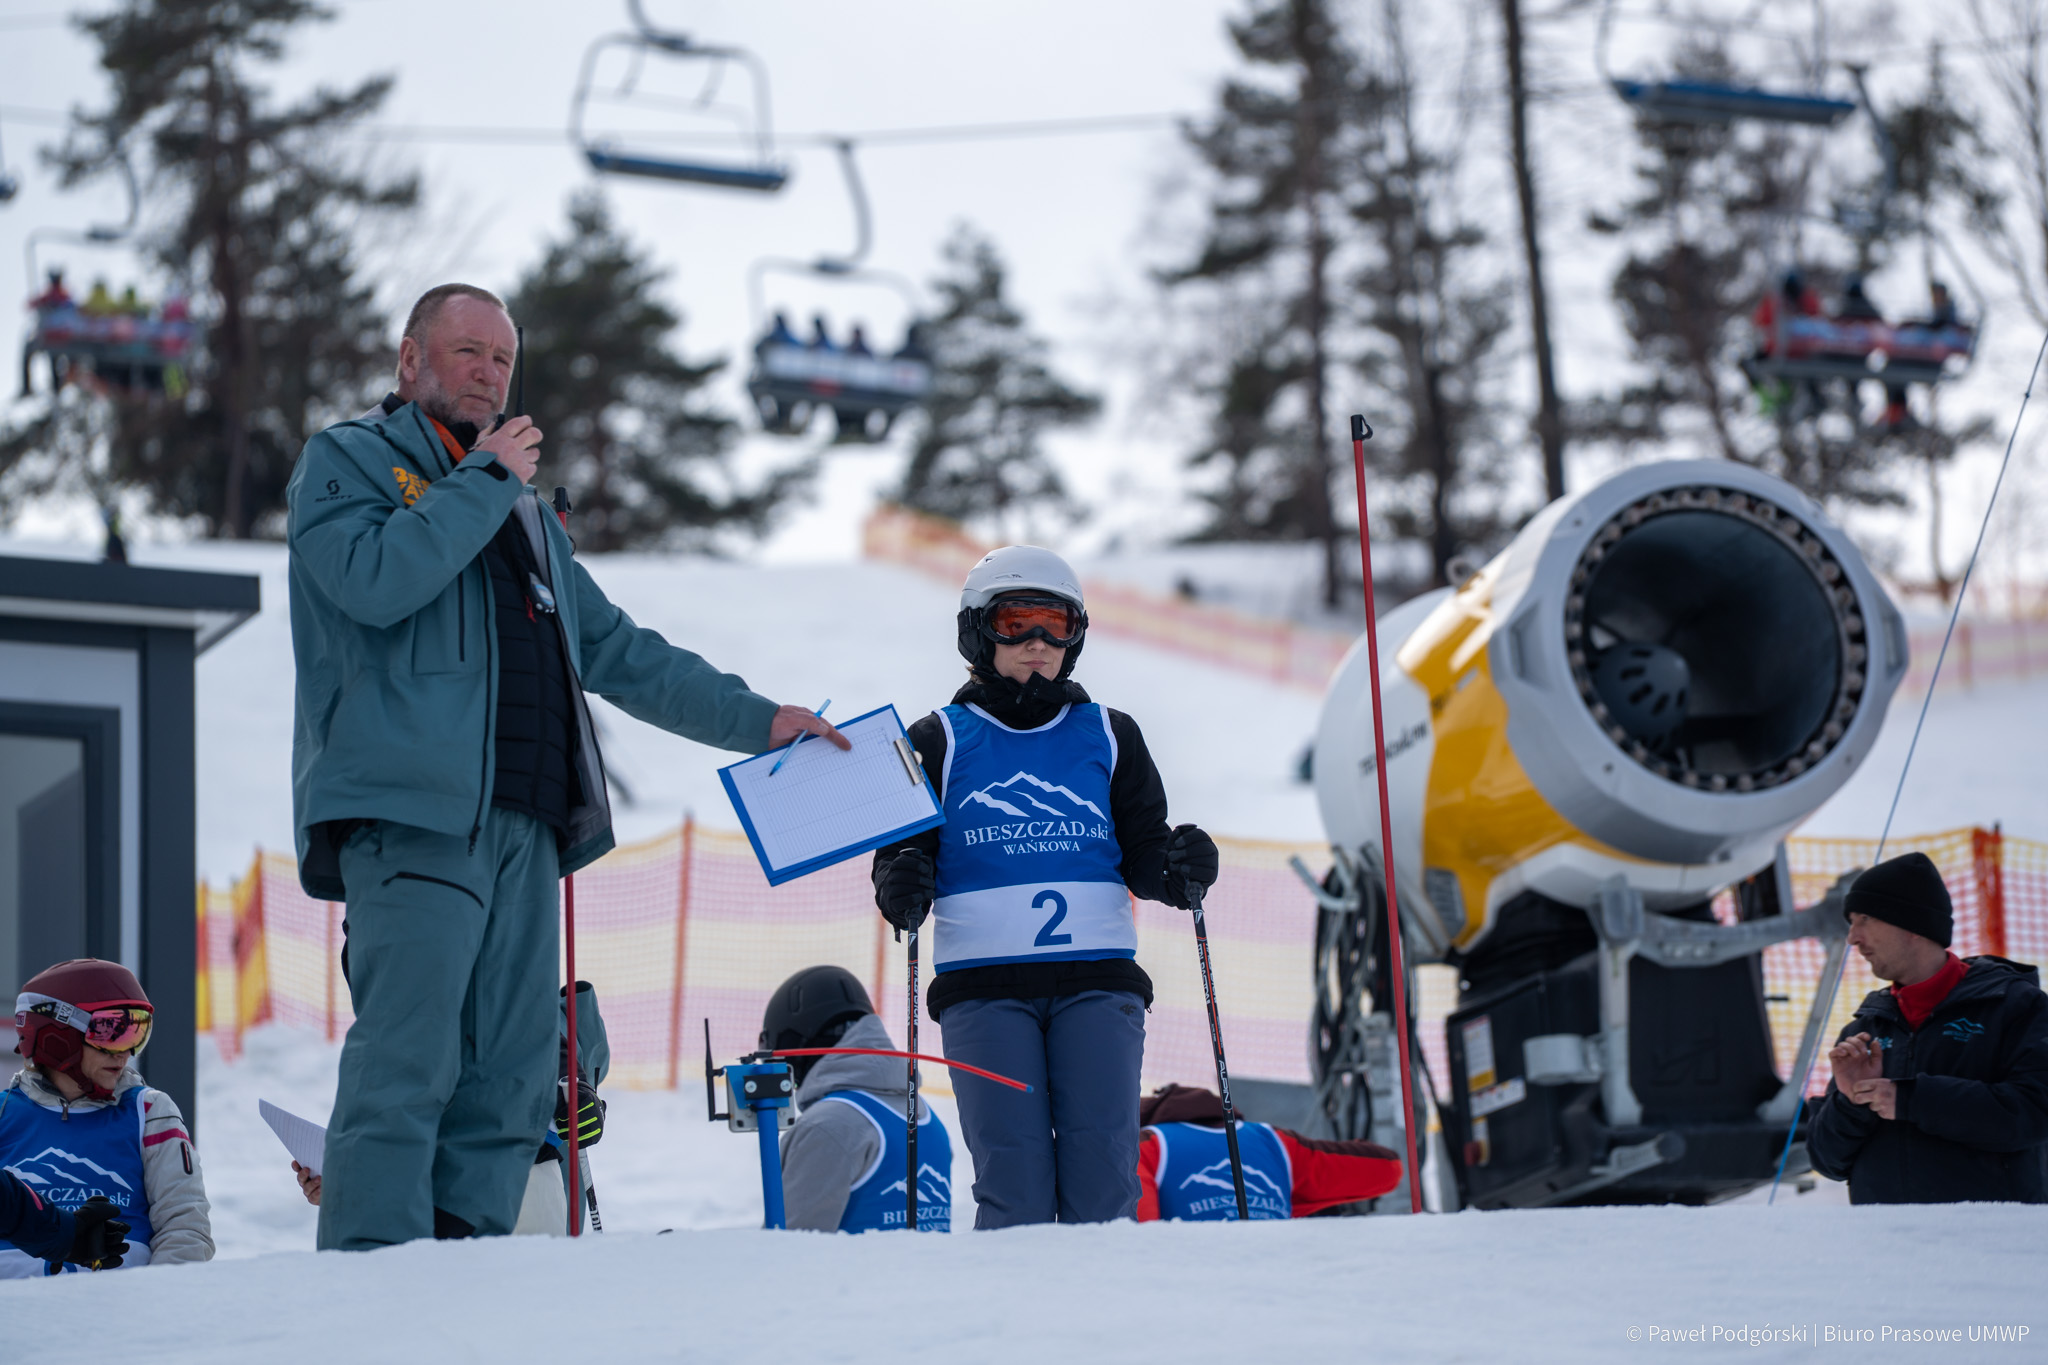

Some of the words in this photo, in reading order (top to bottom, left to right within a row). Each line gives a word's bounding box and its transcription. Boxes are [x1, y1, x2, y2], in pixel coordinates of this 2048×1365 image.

[963, 821, 1109, 846] BIESZCZAD.ski
[1003, 840, 1081, 855] WAŃKOWA
[1031, 889, 1073, 948] 2
[1218, 1060, 1231, 1104] ALPIN
